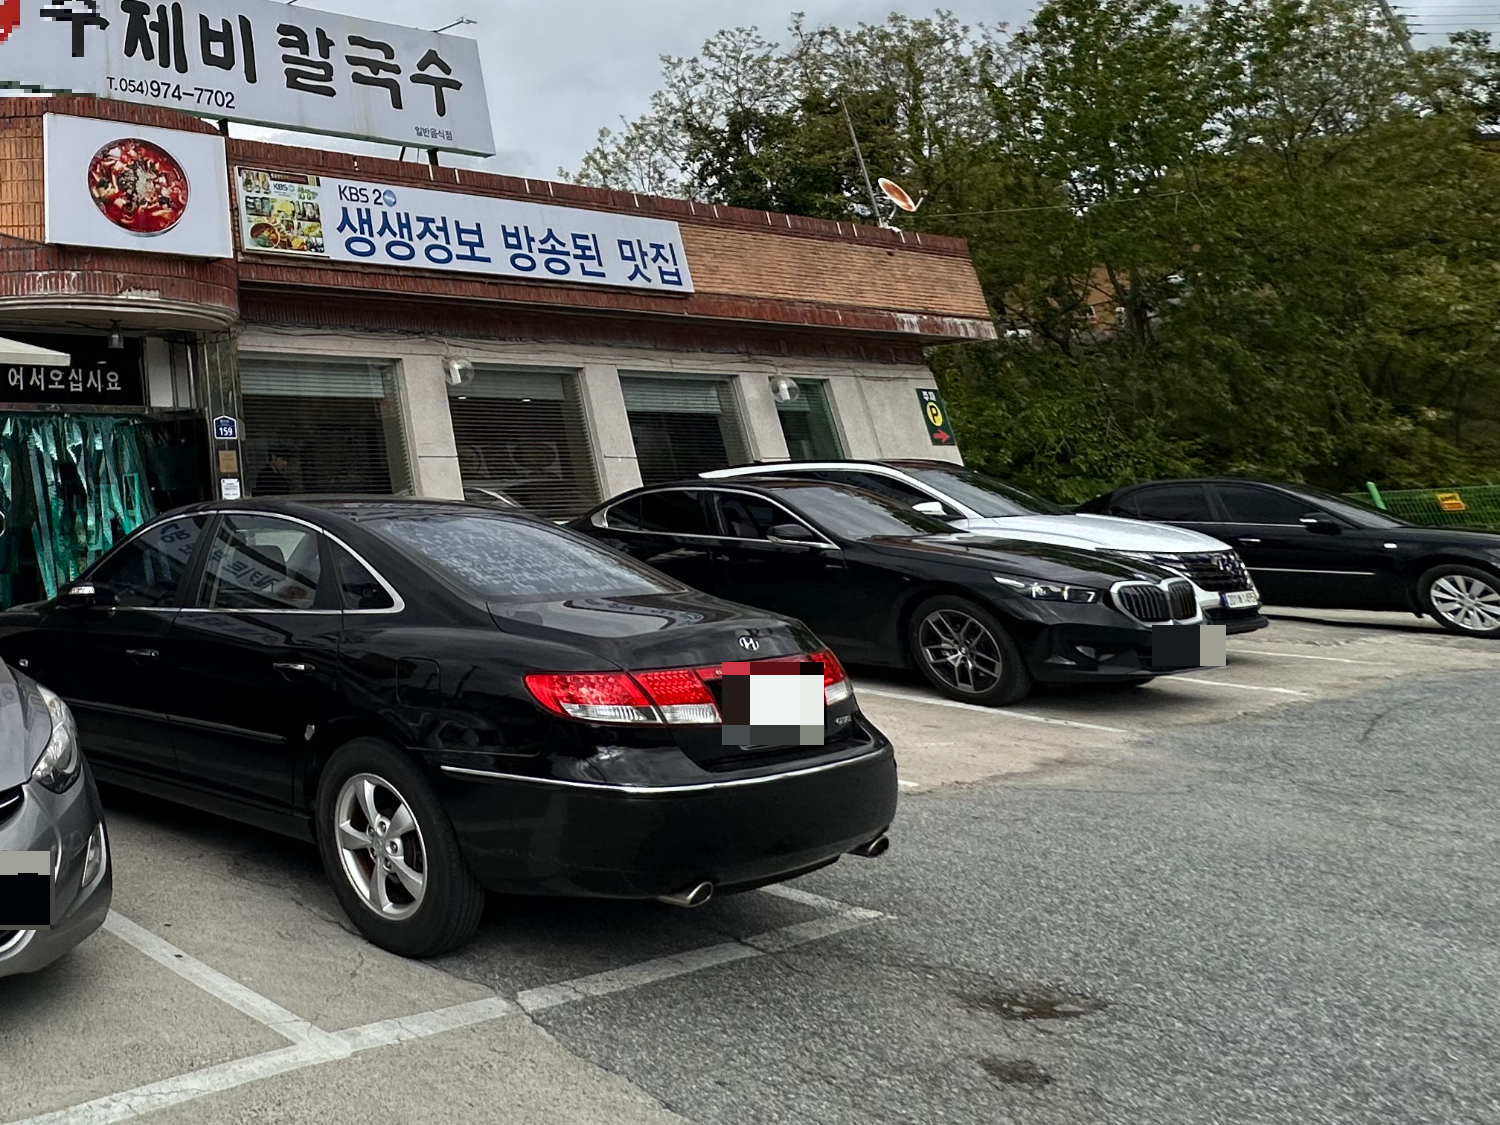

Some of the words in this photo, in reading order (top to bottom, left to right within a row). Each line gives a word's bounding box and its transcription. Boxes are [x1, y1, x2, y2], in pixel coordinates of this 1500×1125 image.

[277, 22, 462, 117] 칼국수
[414, 125, 453, 141] 일반음식점
[273, 182, 289, 191] KBS
[338, 184, 369, 203] KBS
[336, 206, 492, 264] 생생정보
[500, 225, 606, 278] 방송된
[617, 239, 683, 286] 맛집
[8, 366, 121, 393] 어서오십시요
[219, 426, 233, 436] 159
